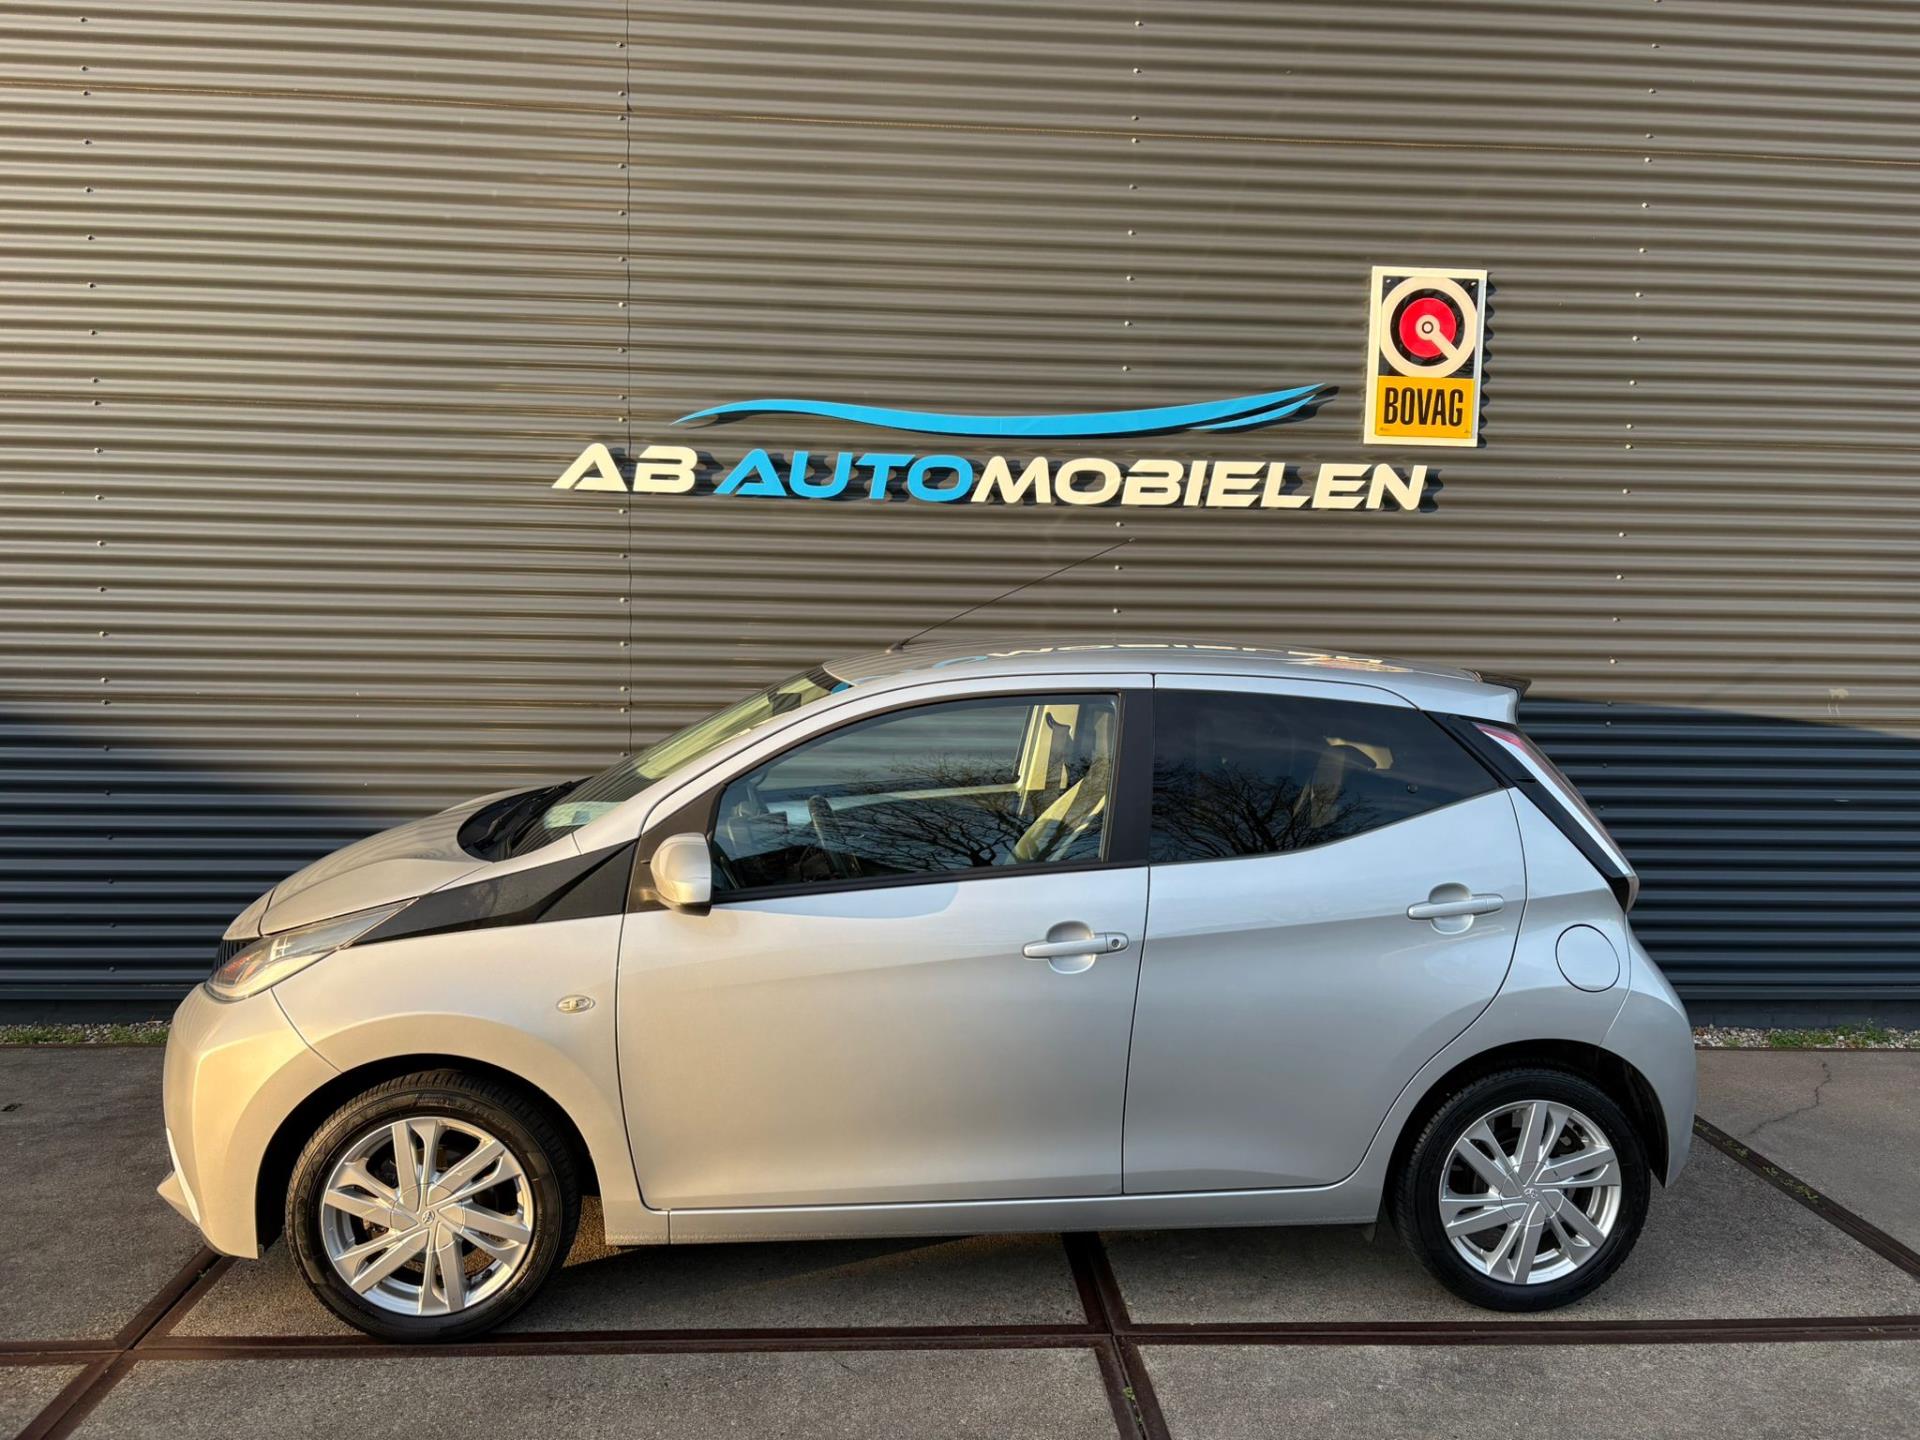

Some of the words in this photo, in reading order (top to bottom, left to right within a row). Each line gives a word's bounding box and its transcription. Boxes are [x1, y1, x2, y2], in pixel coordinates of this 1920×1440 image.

[1383, 387, 1464, 427] BOVAG
[551, 442, 698, 493] AB
[713, 448, 1427, 511] AUTOMOBIELEN
